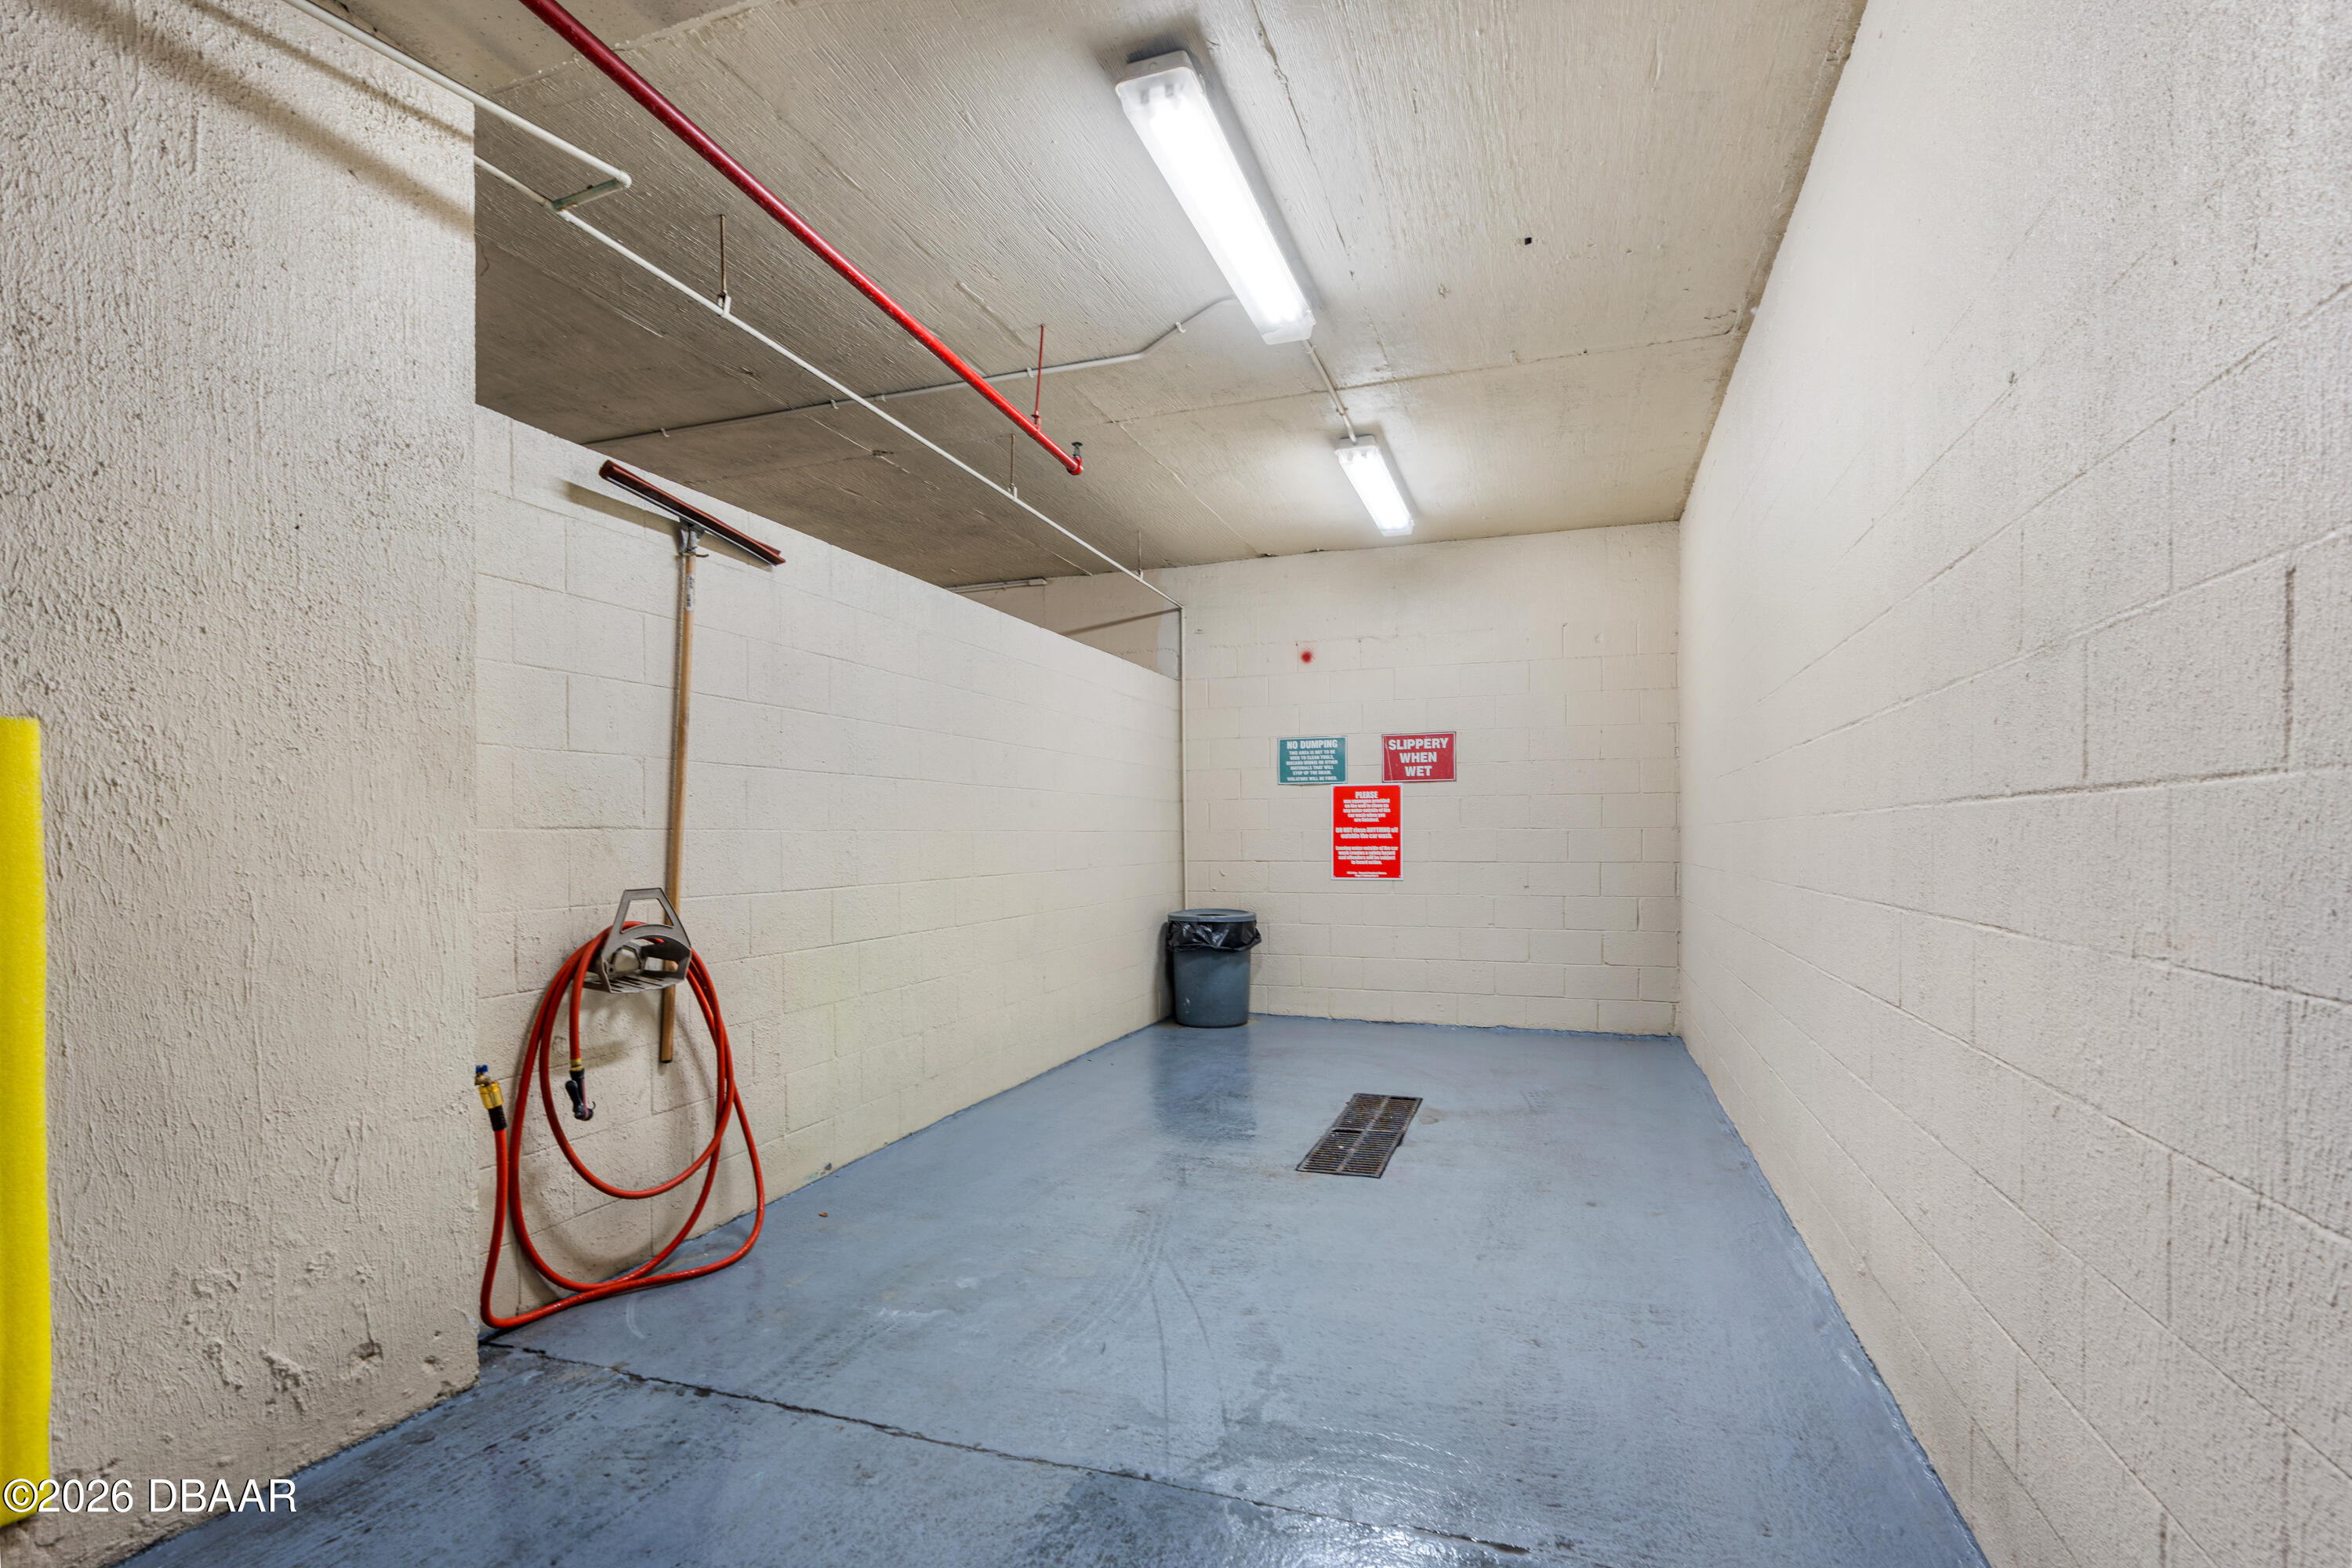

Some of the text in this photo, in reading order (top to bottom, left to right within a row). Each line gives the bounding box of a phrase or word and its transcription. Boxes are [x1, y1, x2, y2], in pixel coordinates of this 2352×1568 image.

[1300, 739, 1338, 749] DUMPING
[1388, 738, 1449, 750] SLIPPERY
[1399, 752, 1437, 764] WHEN
[1405, 766, 1432, 776] WET
